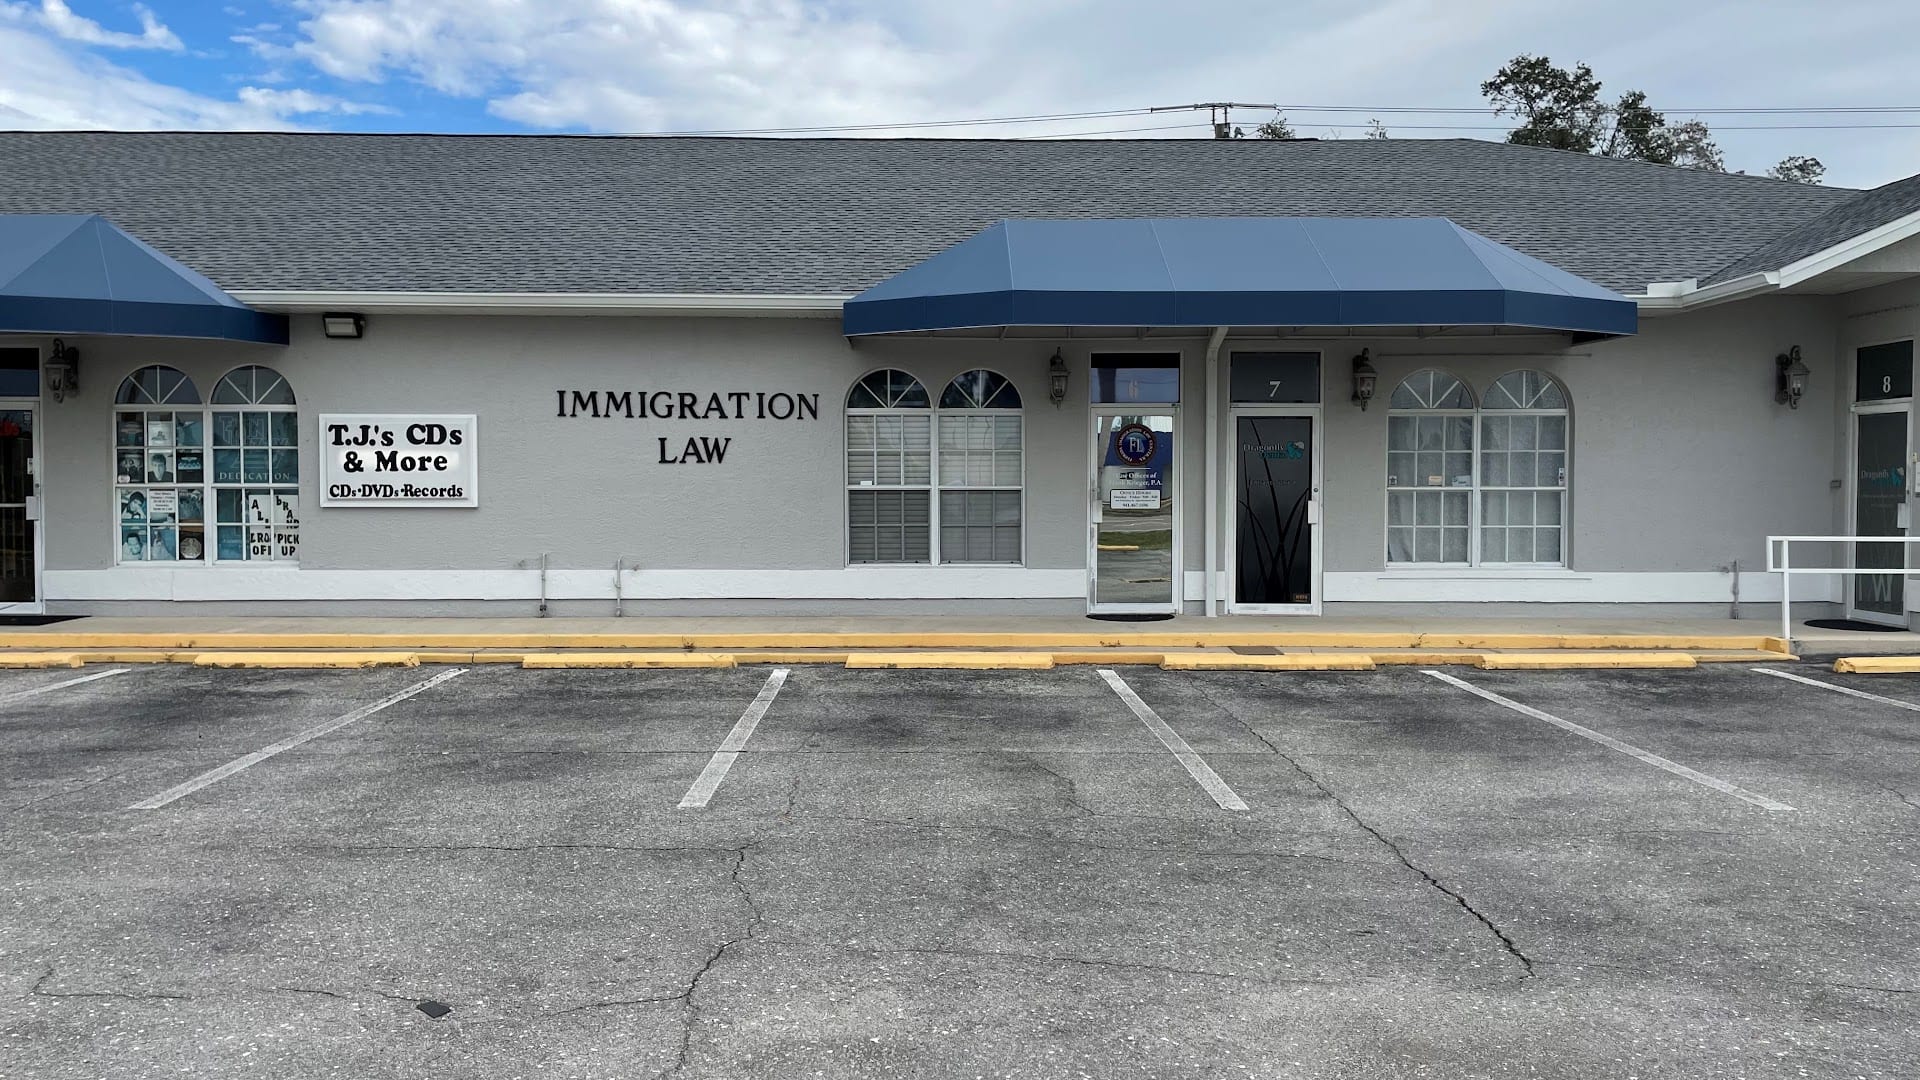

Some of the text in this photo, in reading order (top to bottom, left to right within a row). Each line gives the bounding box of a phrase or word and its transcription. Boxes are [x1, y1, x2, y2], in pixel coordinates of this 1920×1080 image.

[1270, 381, 1280, 397] 7
[1883, 376, 1891, 393] 8
[557, 390, 819, 420] IMMIGRATION
[328, 424, 462, 446] T.J.'s CDs
[658, 437, 731, 464] LAW
[343, 451, 448, 472] & More
[219, 472, 290, 480] DEDICATON
[278, 533, 300, 545] PICK
[281, 546, 296, 556] UP
